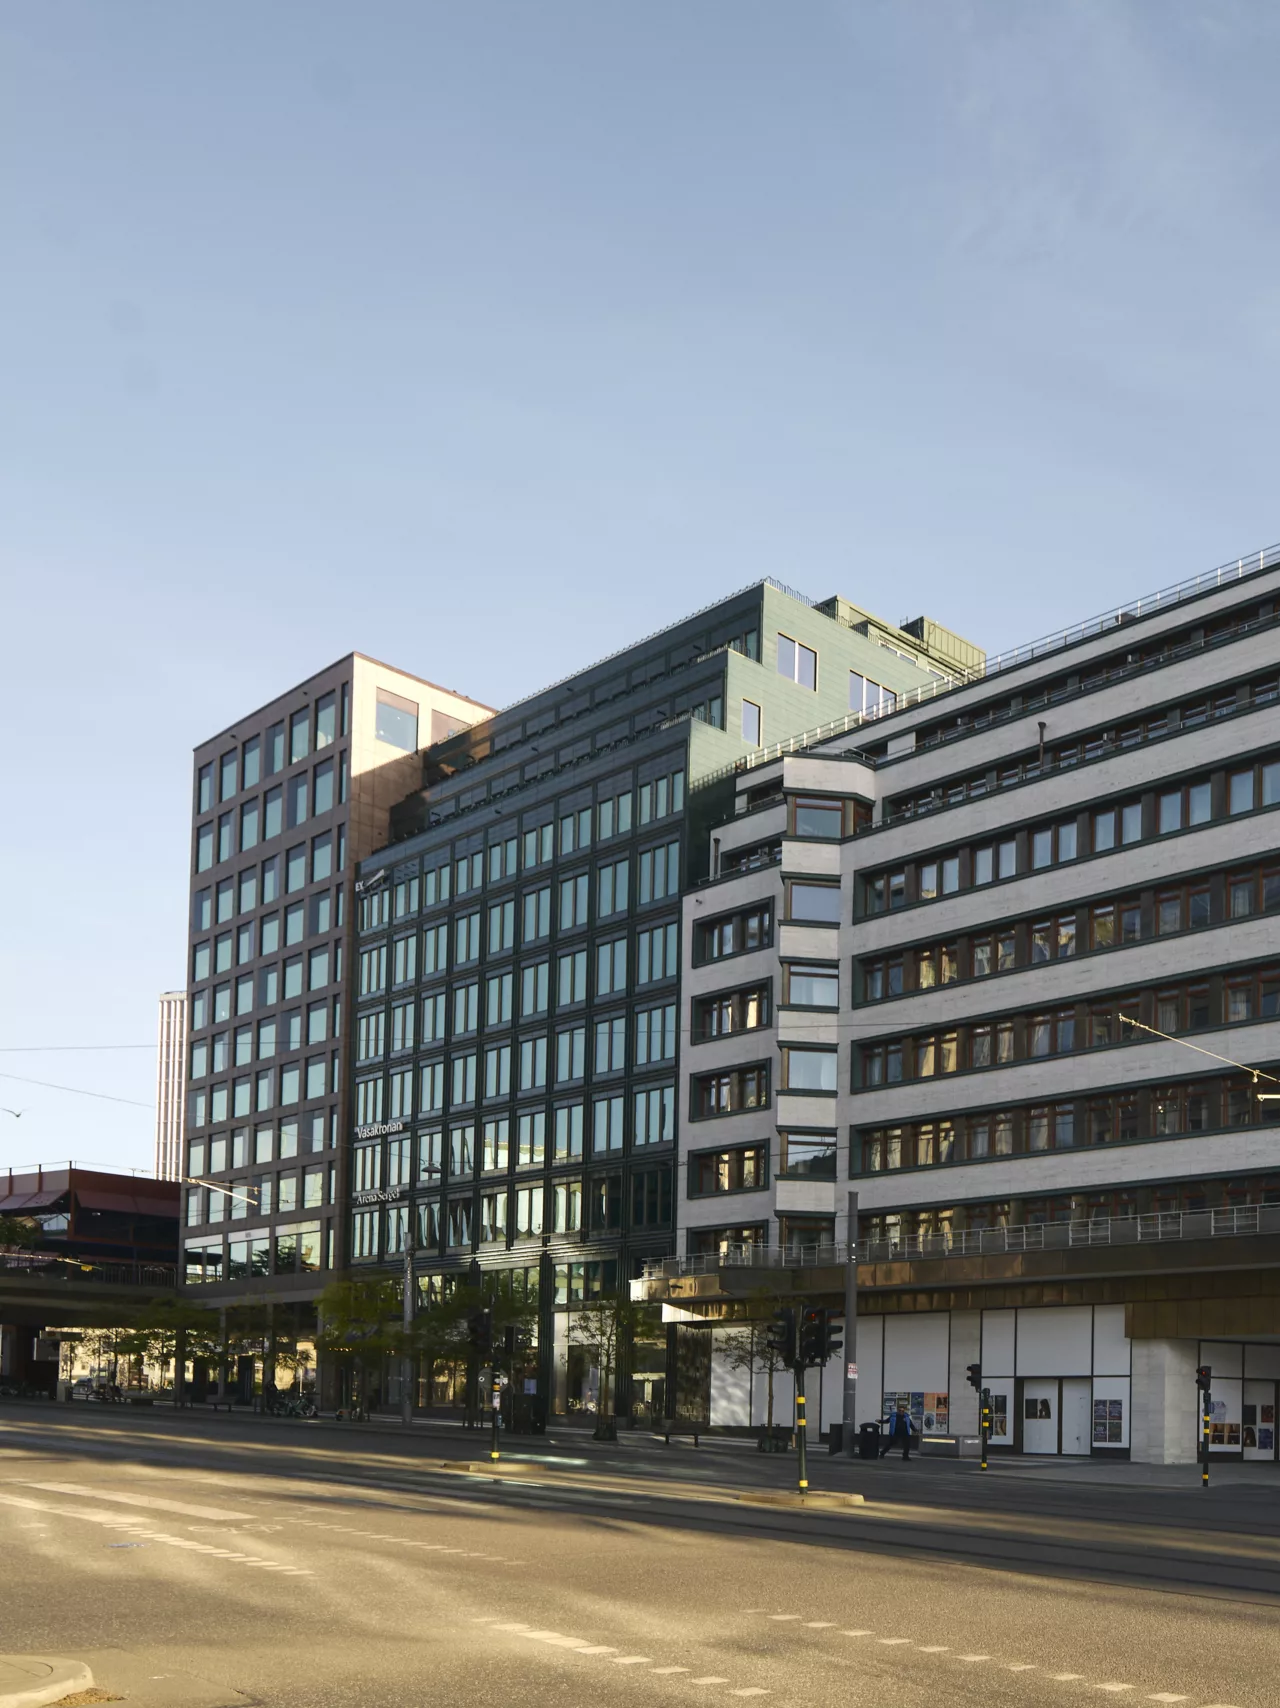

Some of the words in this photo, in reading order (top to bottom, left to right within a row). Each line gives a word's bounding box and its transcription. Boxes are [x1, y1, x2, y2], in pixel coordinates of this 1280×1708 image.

[357, 1121, 403, 1139] Vasakronan
[357, 1194, 377, 1204] Arena
[377, 1188, 400, 1201] Sergel
